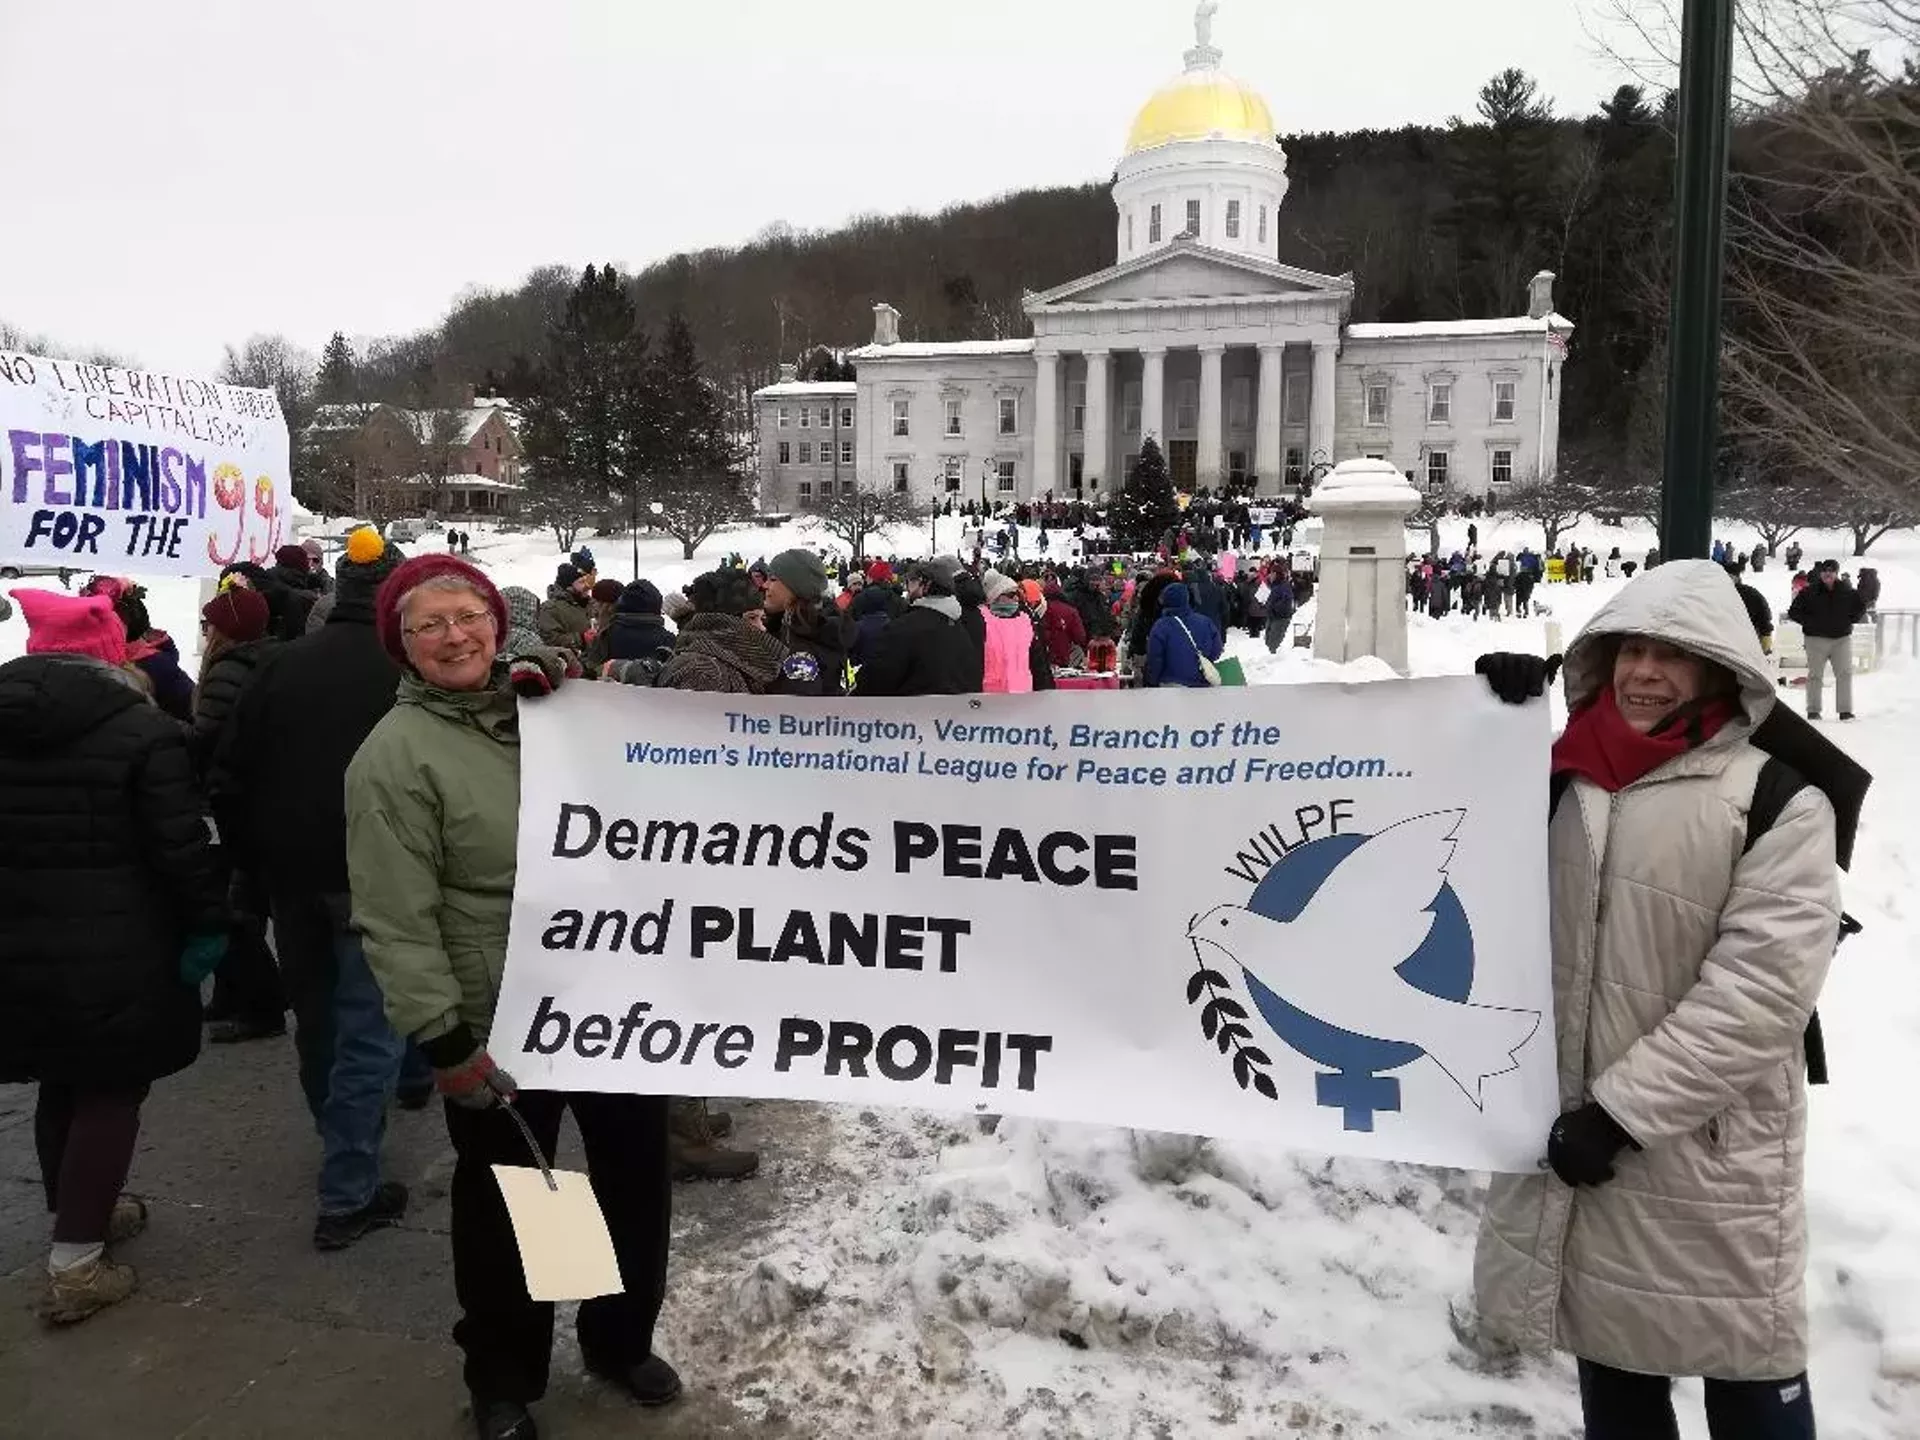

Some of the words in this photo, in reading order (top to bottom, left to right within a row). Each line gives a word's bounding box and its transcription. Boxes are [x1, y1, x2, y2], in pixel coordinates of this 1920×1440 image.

[52, 361, 223, 411] LIBERATION
[86, 395, 246, 451] CAPITALISM
[8, 429, 207, 519] FEMINISM
[24, 509, 105, 554] FOR
[125, 514, 188, 558] THE
[725, 712, 771, 735] The
[779, 714, 924, 744] Burlington,
[934, 719, 1058, 750] Vermont,
[1069, 723, 1179, 749] Branch
[1190, 722, 1225, 747] of
[1231, 721, 1281, 746] the
[747, 744, 909, 774] International
[917, 751, 1017, 783] League
[1026, 756, 1068, 781] for
[1076, 758, 1167, 786] Peace
[1176, 758, 1236, 784] and
[1244, 755, 1413, 784] Freedom...
[552, 803, 871, 872] Demands
[894, 820, 1138, 891] PEACE
[1224, 799, 1355, 885] WILPF
[541, 899, 674, 956] and
[690, 905, 972, 973] PLANET
[522, 996, 755, 1070] before
[774, 1018, 1053, 1092] PROFIT
